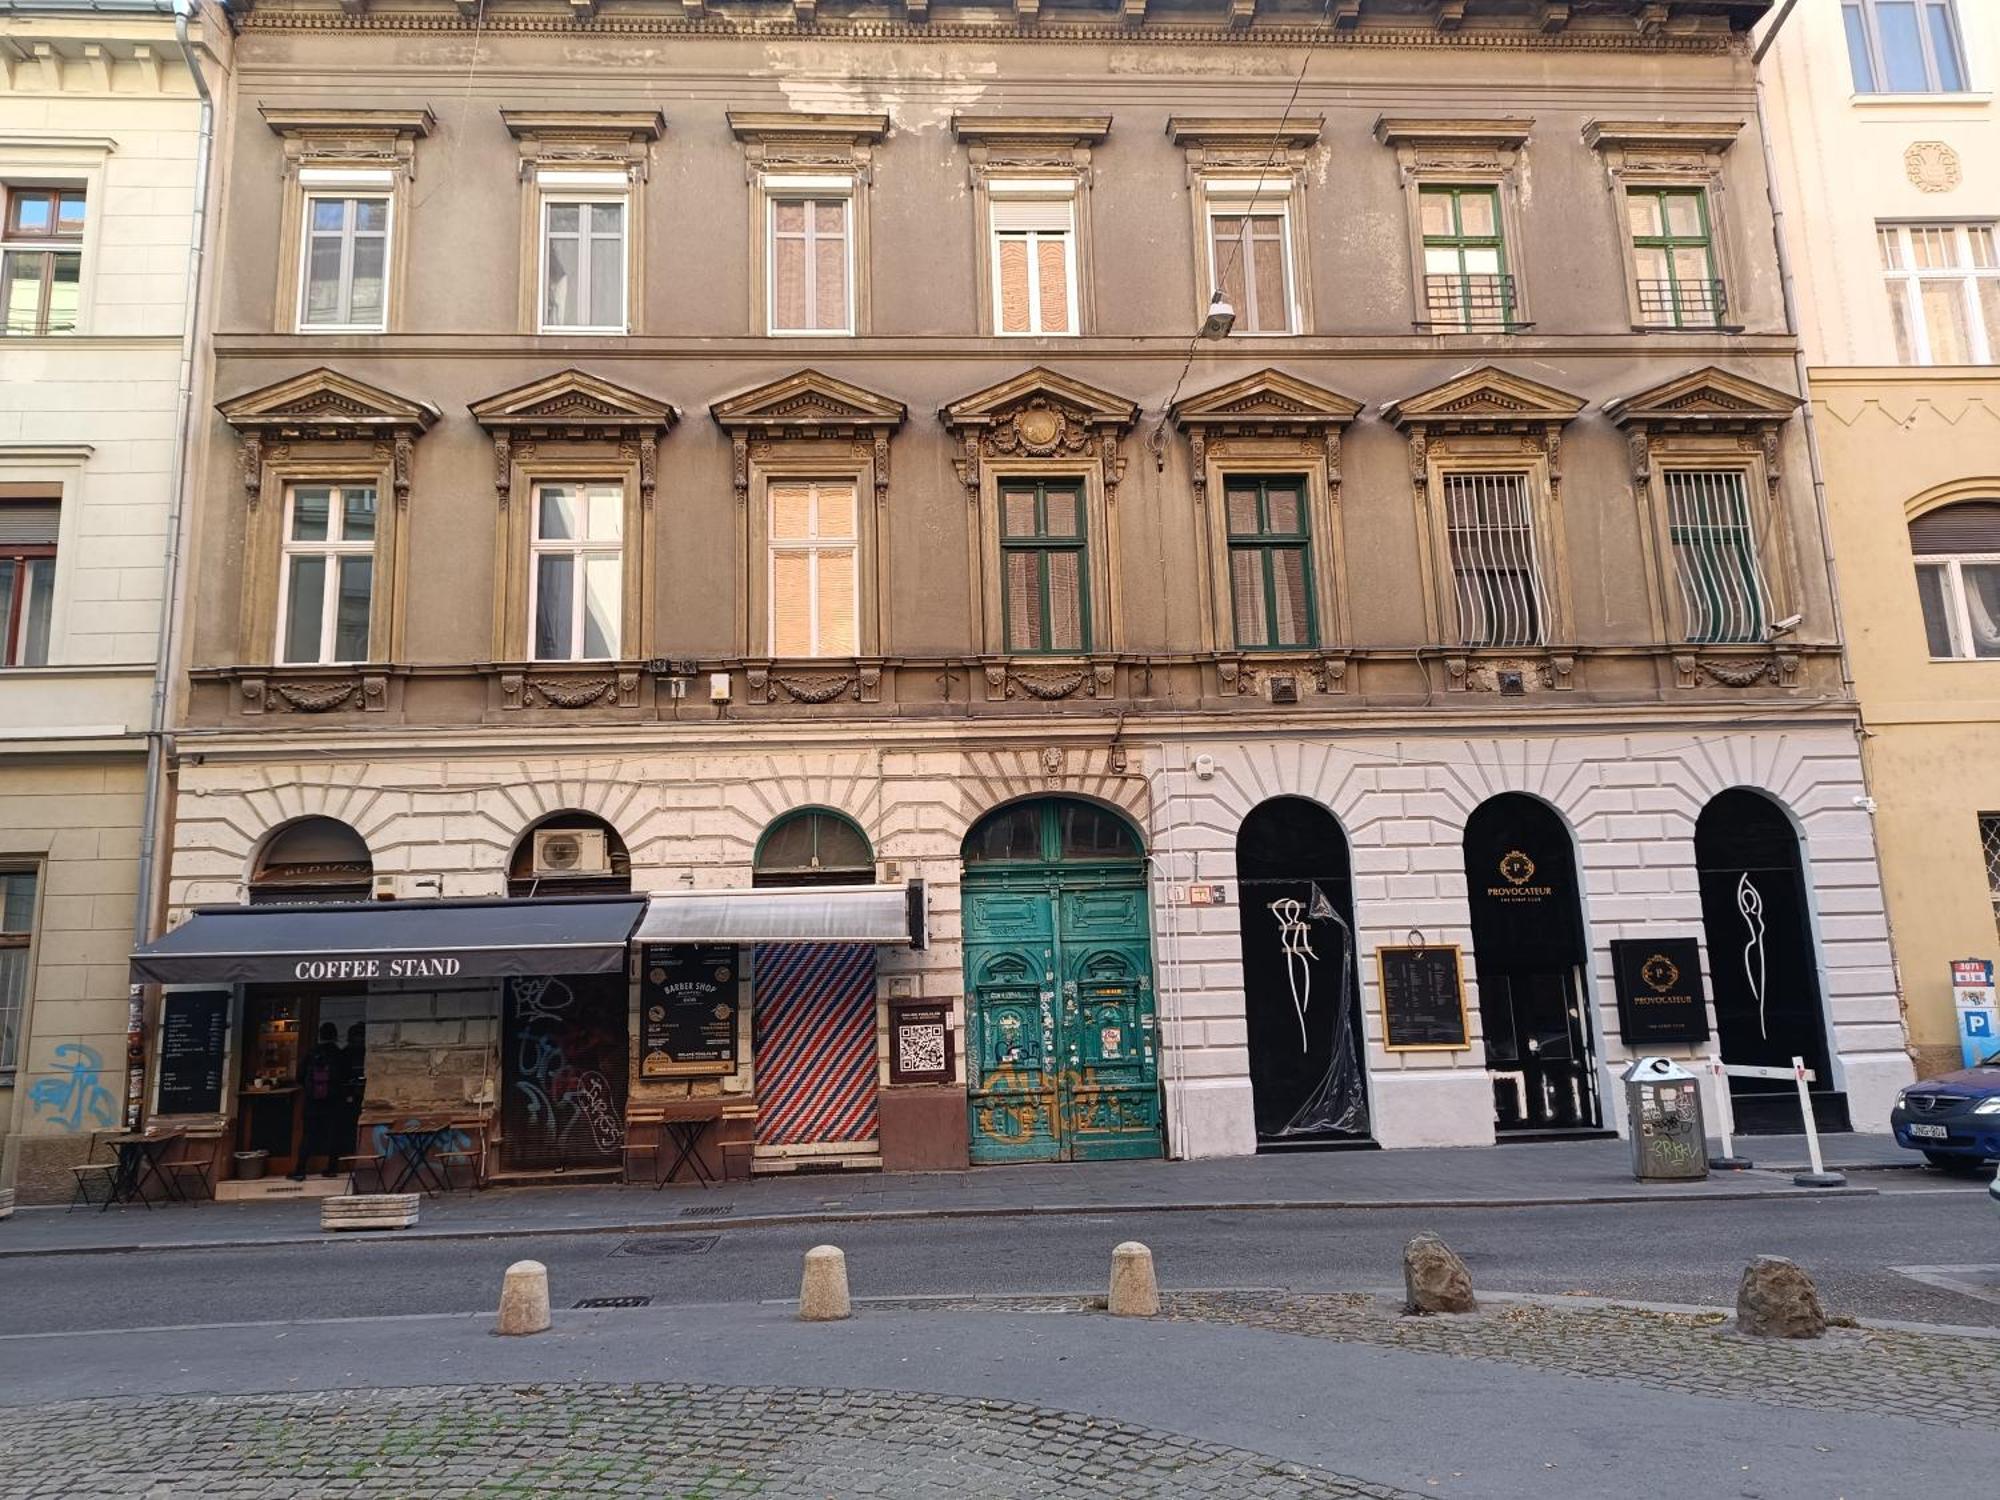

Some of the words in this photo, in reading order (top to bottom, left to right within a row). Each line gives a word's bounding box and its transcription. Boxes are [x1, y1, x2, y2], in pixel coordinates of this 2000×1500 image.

[1487, 887, 1552, 896] PROVOCATEUR
[295, 960, 380, 980] COFFEE
[390, 958, 461, 977] STAND
[664, 982, 694, 995] BARBER
[695, 982, 717, 993] SHOP
[1633, 995, 1692, 1006] PROVOCATEUR
[1969, 1015, 1985, 1033] P
